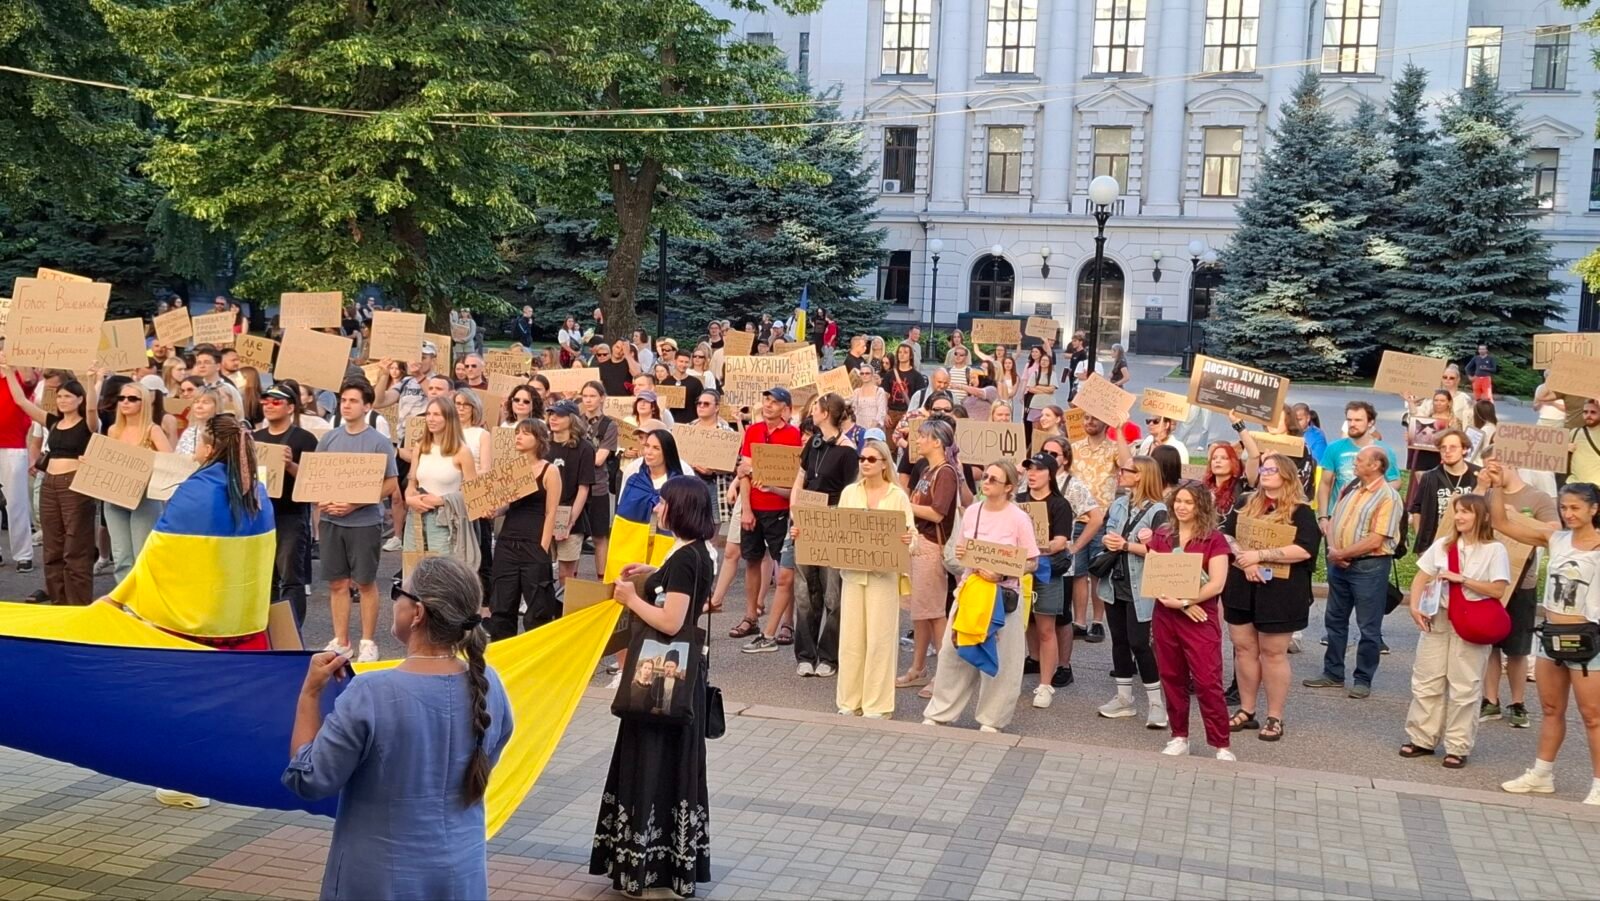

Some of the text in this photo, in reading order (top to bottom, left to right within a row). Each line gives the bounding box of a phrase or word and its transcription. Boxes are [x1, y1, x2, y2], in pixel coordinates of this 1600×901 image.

[726, 357, 746, 373] БІДА
[749, 357, 790, 374] УКРАЇНИ
[1202, 360, 1280, 389] ДОСИТЬ ДУМАТЬ
[1215, 379, 1261, 400] СХЕМАМИ
[1142, 398, 1184, 415] САБОТАЖ
[677, 425, 697, 437] ПРИ
[1498, 424, 1565, 446] СИРСЬКОГО
[88, 437, 150, 473] ПОВЕРНІТЬ
[304, 481, 332, 494] ГЕТЬ
[463, 469, 498, 494] ТРИМАЮ
[798, 509, 898, 533] ГАНЕБНІ РІШЕННЯ
[802, 528, 891, 547] ВІДДАЛЯЮТЬ НАС
[810, 548, 899, 568] ВІД ПЕРЕМОГИ
